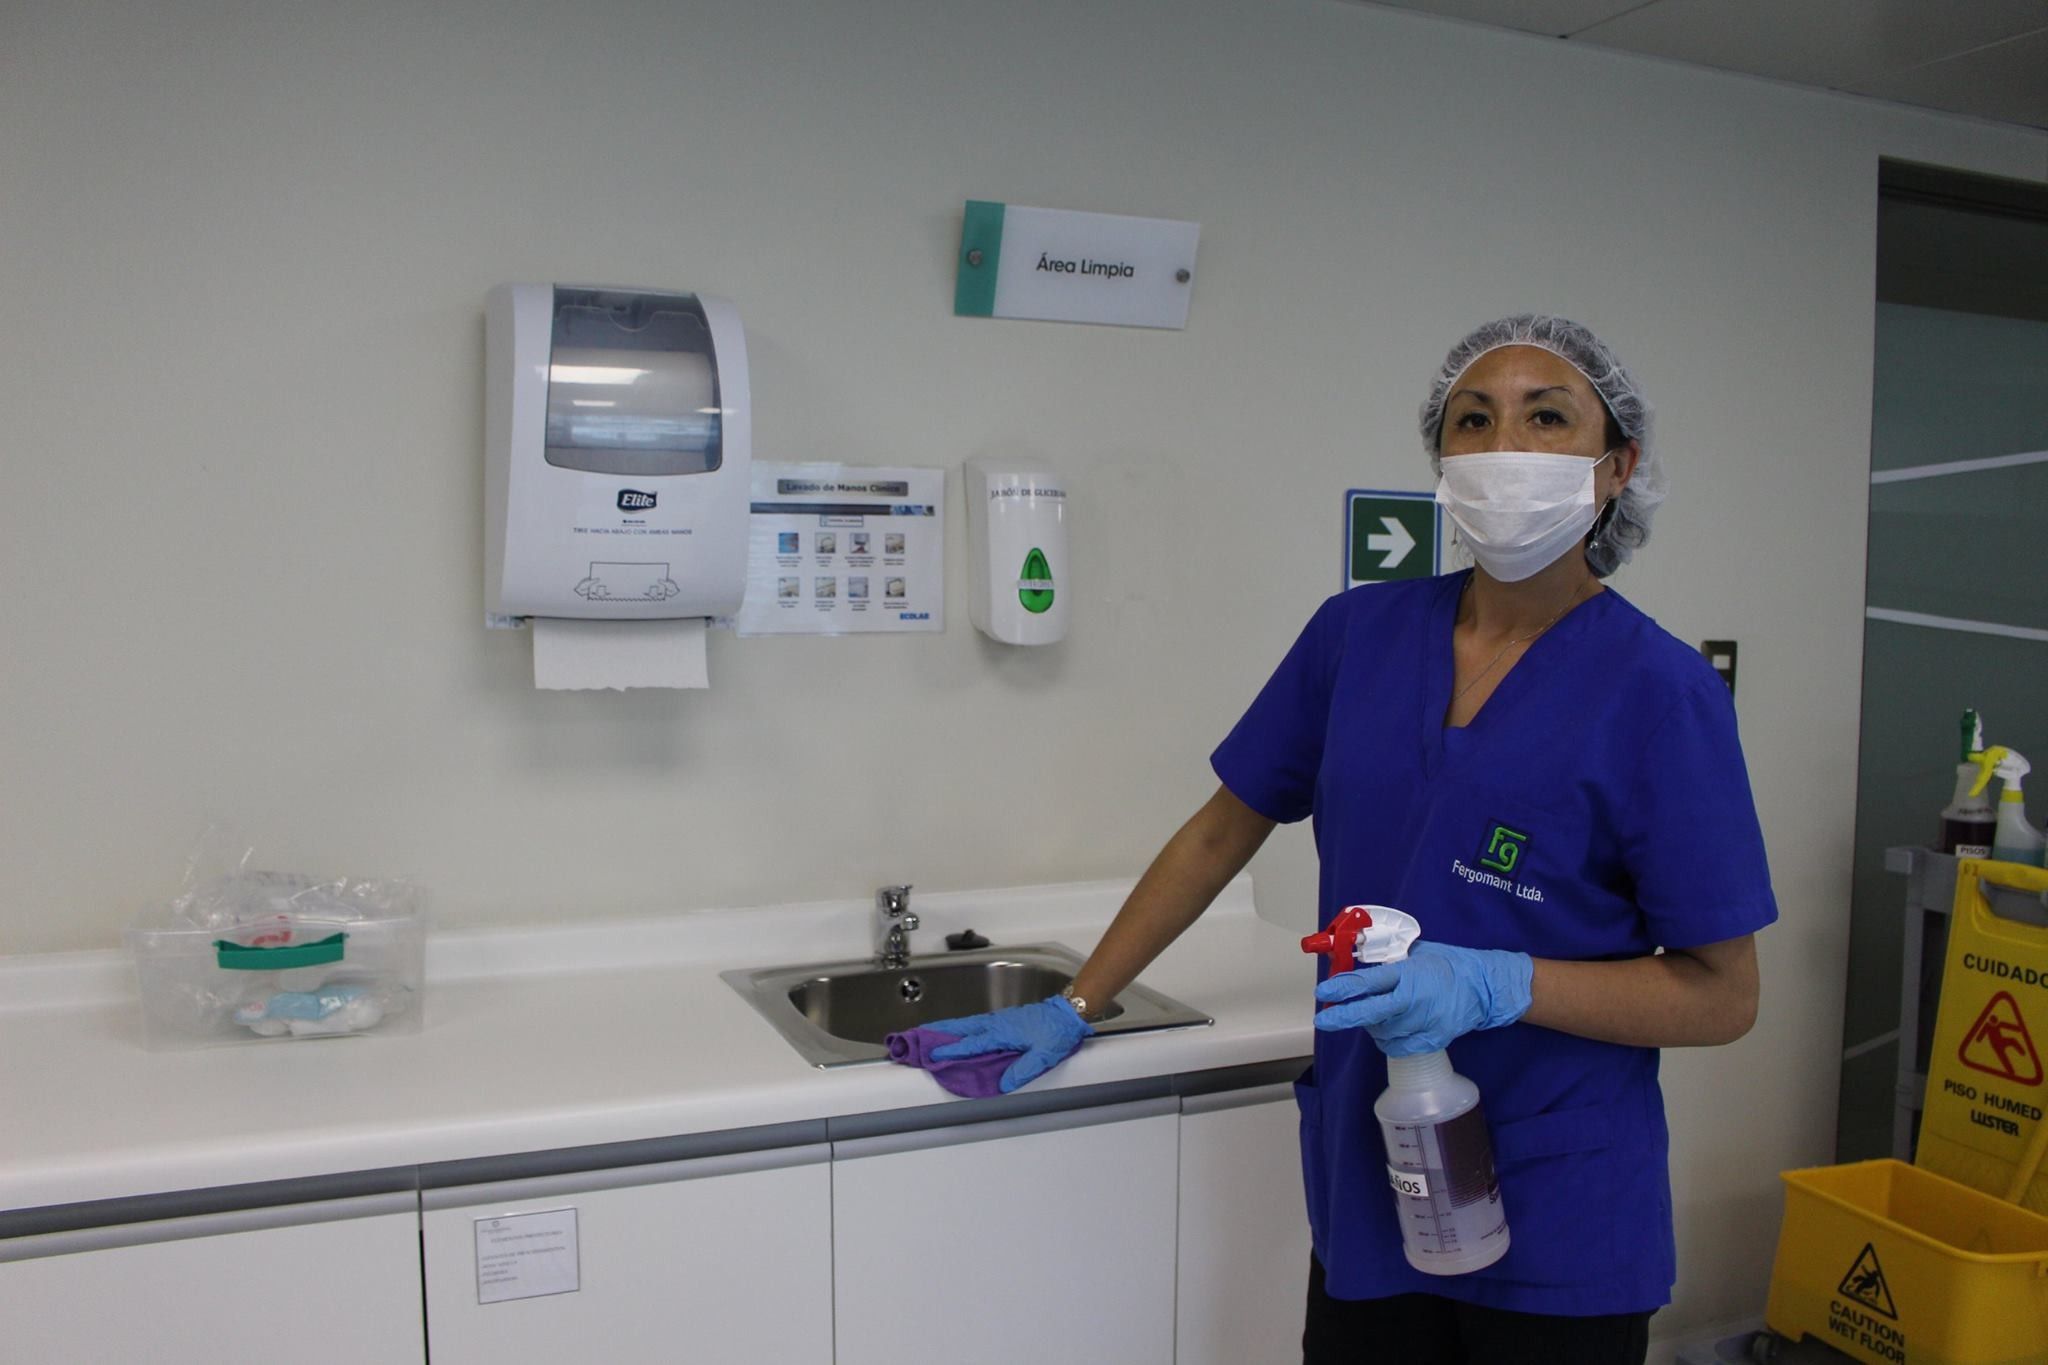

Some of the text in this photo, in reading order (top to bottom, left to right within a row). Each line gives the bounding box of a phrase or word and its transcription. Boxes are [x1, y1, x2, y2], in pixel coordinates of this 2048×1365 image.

[1036, 252, 1134, 279] Área Limpia
[621, 493, 655, 507] Elite
[787, 483, 820, 492] Lavado
[823, 483, 835, 492] de
[837, 484, 867, 493] Manos
[900, 612, 930, 620] ECOLAB
[1961, 847, 1985, 855] PISOS
[1452, 859, 1544, 902] Fergomant Ltda.
[1944, 1078, 2042, 1121] PISO HUMED
[1971, 1109, 2019, 1137] LUSTER
[1830, 1300, 1905, 1347] CAUTION
[1829, 1316, 1905, 1365] WET FLOOR
